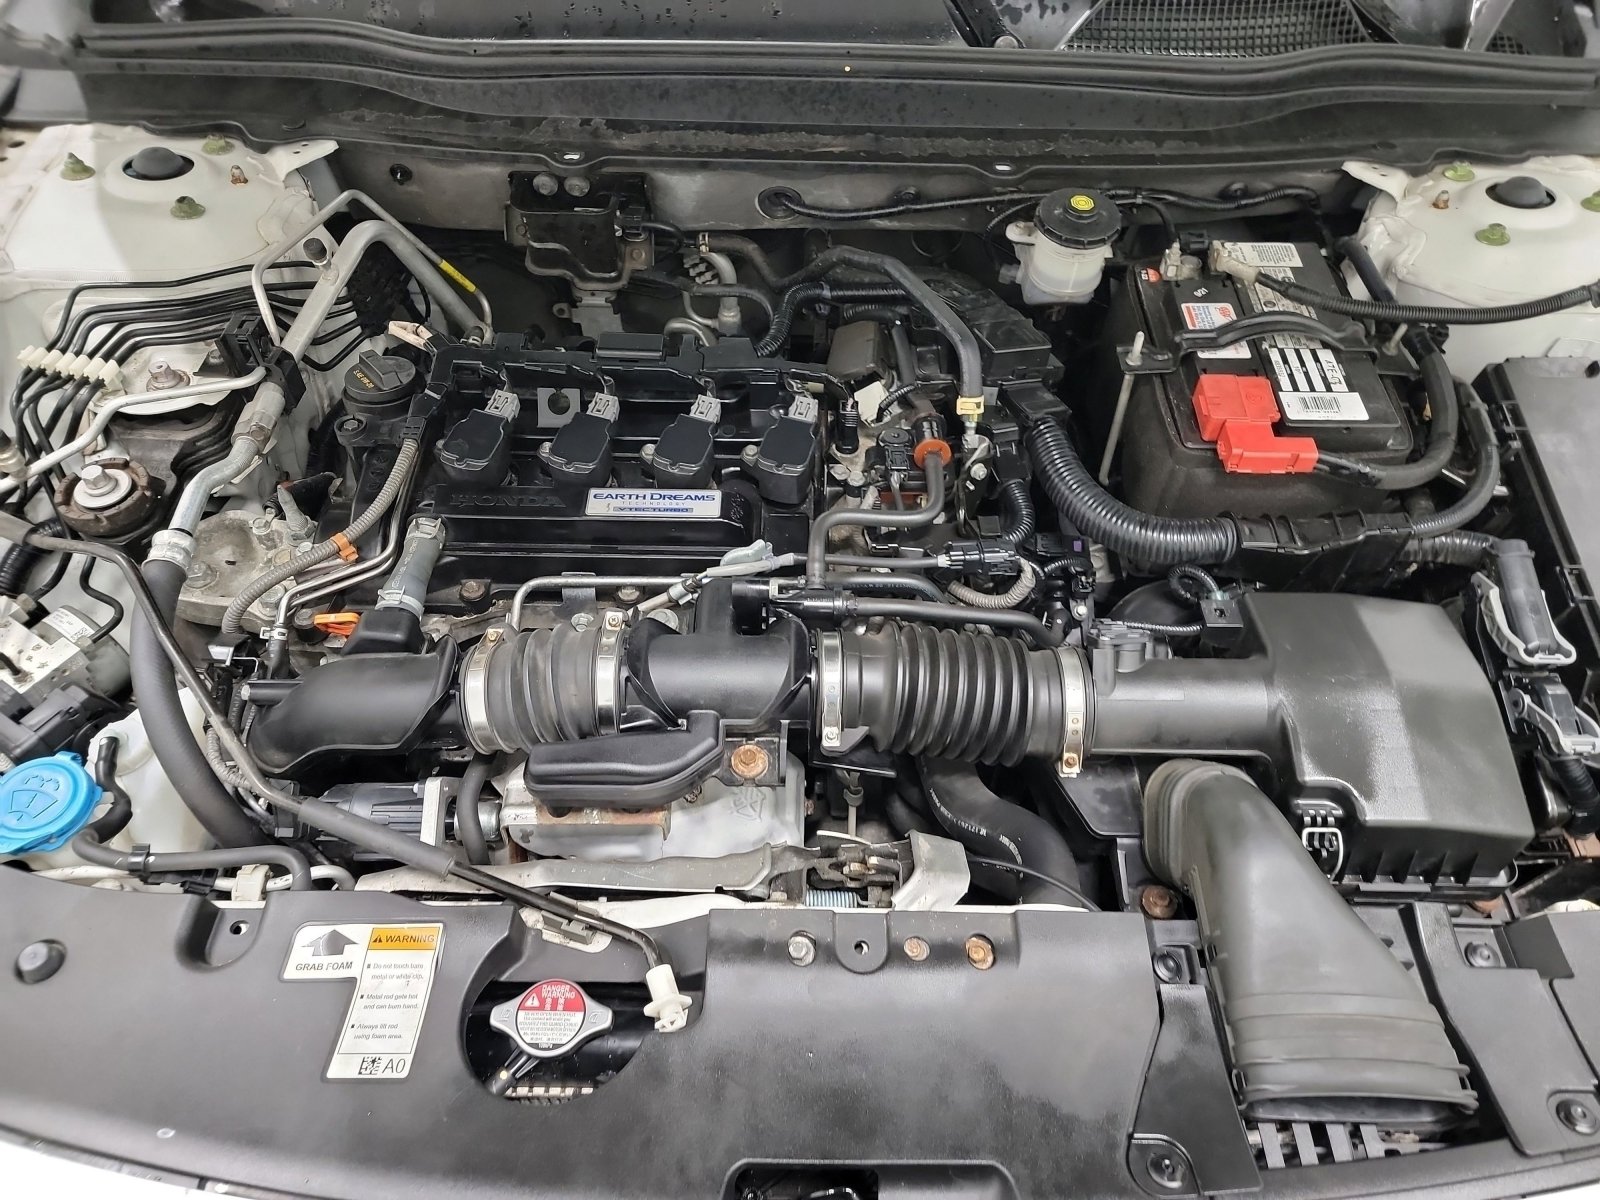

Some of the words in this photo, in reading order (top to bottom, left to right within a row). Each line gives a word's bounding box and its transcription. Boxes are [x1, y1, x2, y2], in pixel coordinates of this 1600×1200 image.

[650, 492, 715, 501] DREAMS
[385, 934, 435, 944] WARNING
[295, 963, 324, 971] GRAB
[325, 961, 353, 971] FOAM
[382, 1058, 406, 1074] A0
